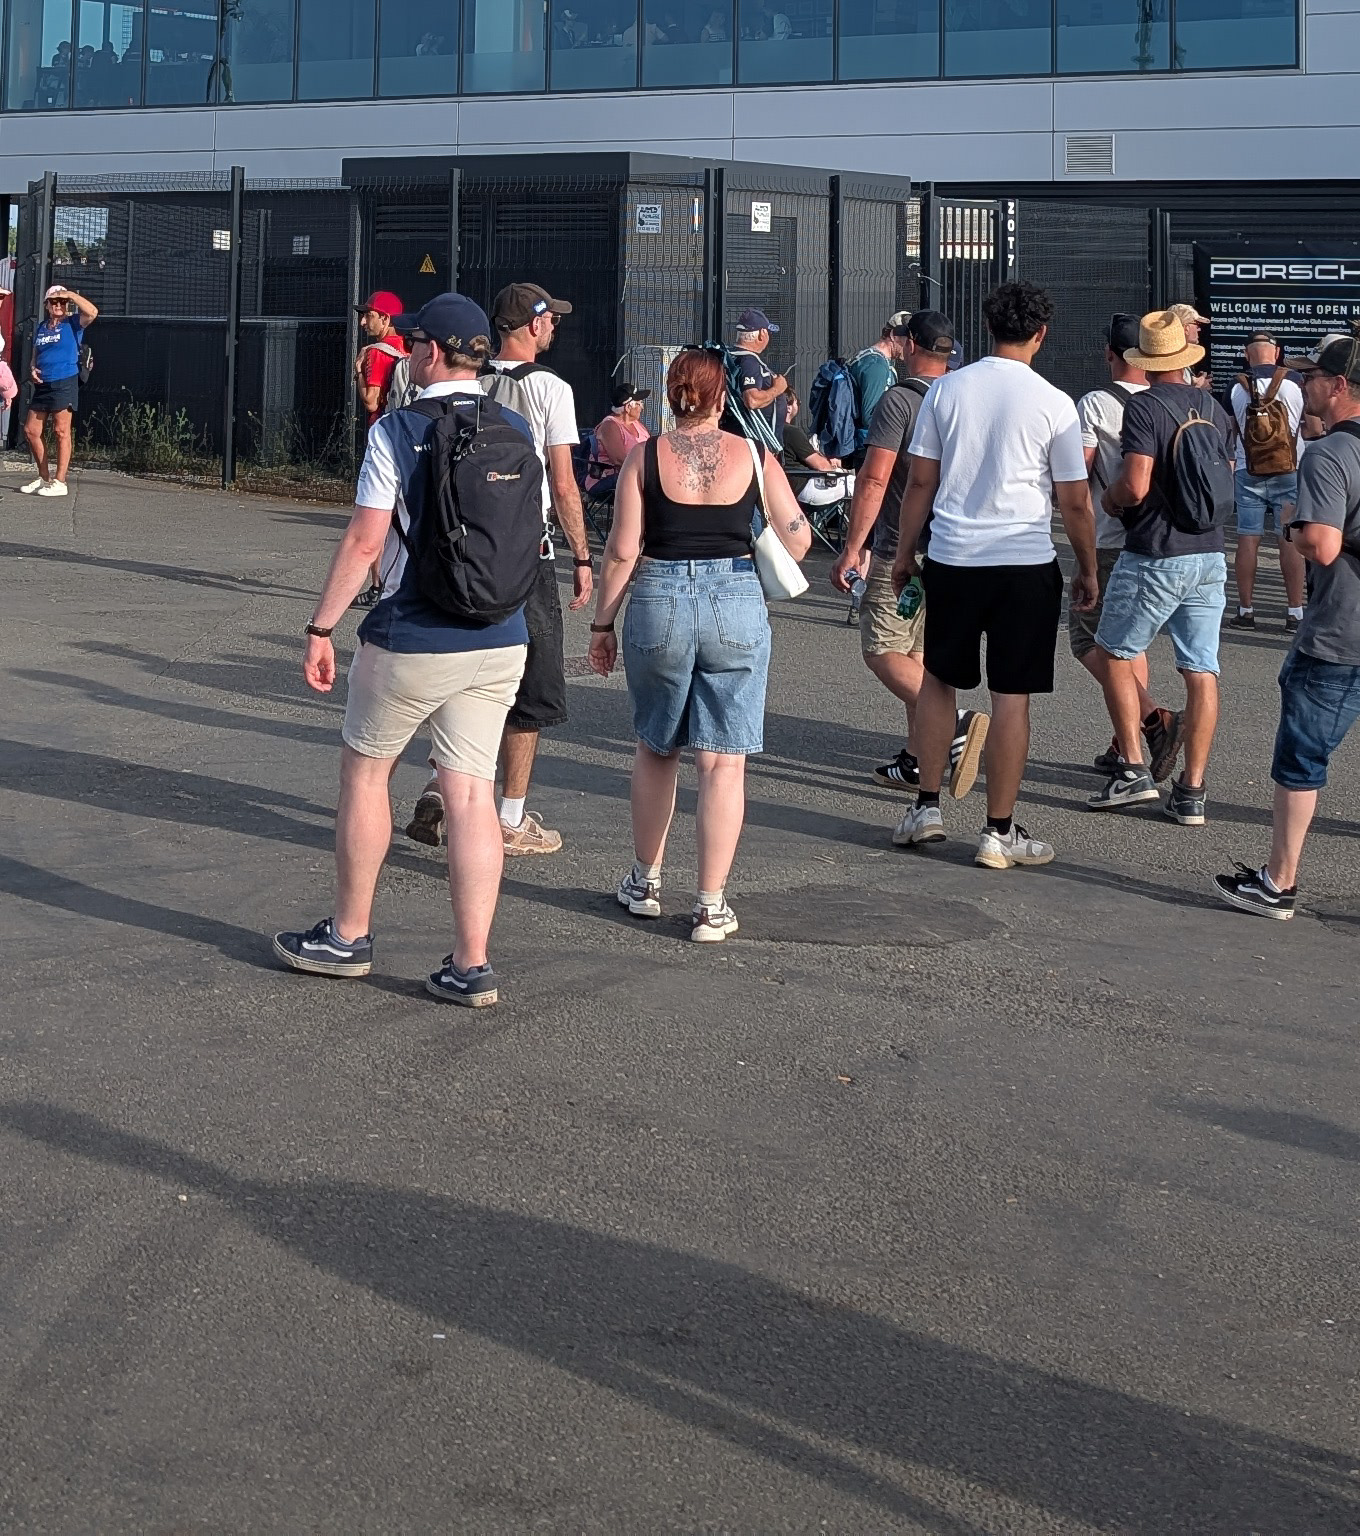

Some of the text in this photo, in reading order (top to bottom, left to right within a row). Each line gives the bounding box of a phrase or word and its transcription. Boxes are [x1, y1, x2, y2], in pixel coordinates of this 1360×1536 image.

[1210, 302, 1267, 314] WELCOME
[1271, 304, 1286, 314] TO
[1290, 304, 1312, 315] THE
[1316, 304, 1348, 316] OPEN
[1246, 316, 1266, 324] Porsche
[1290, 317, 1309, 325] Porsche
[1284, 345, 1305, 353] Opening
